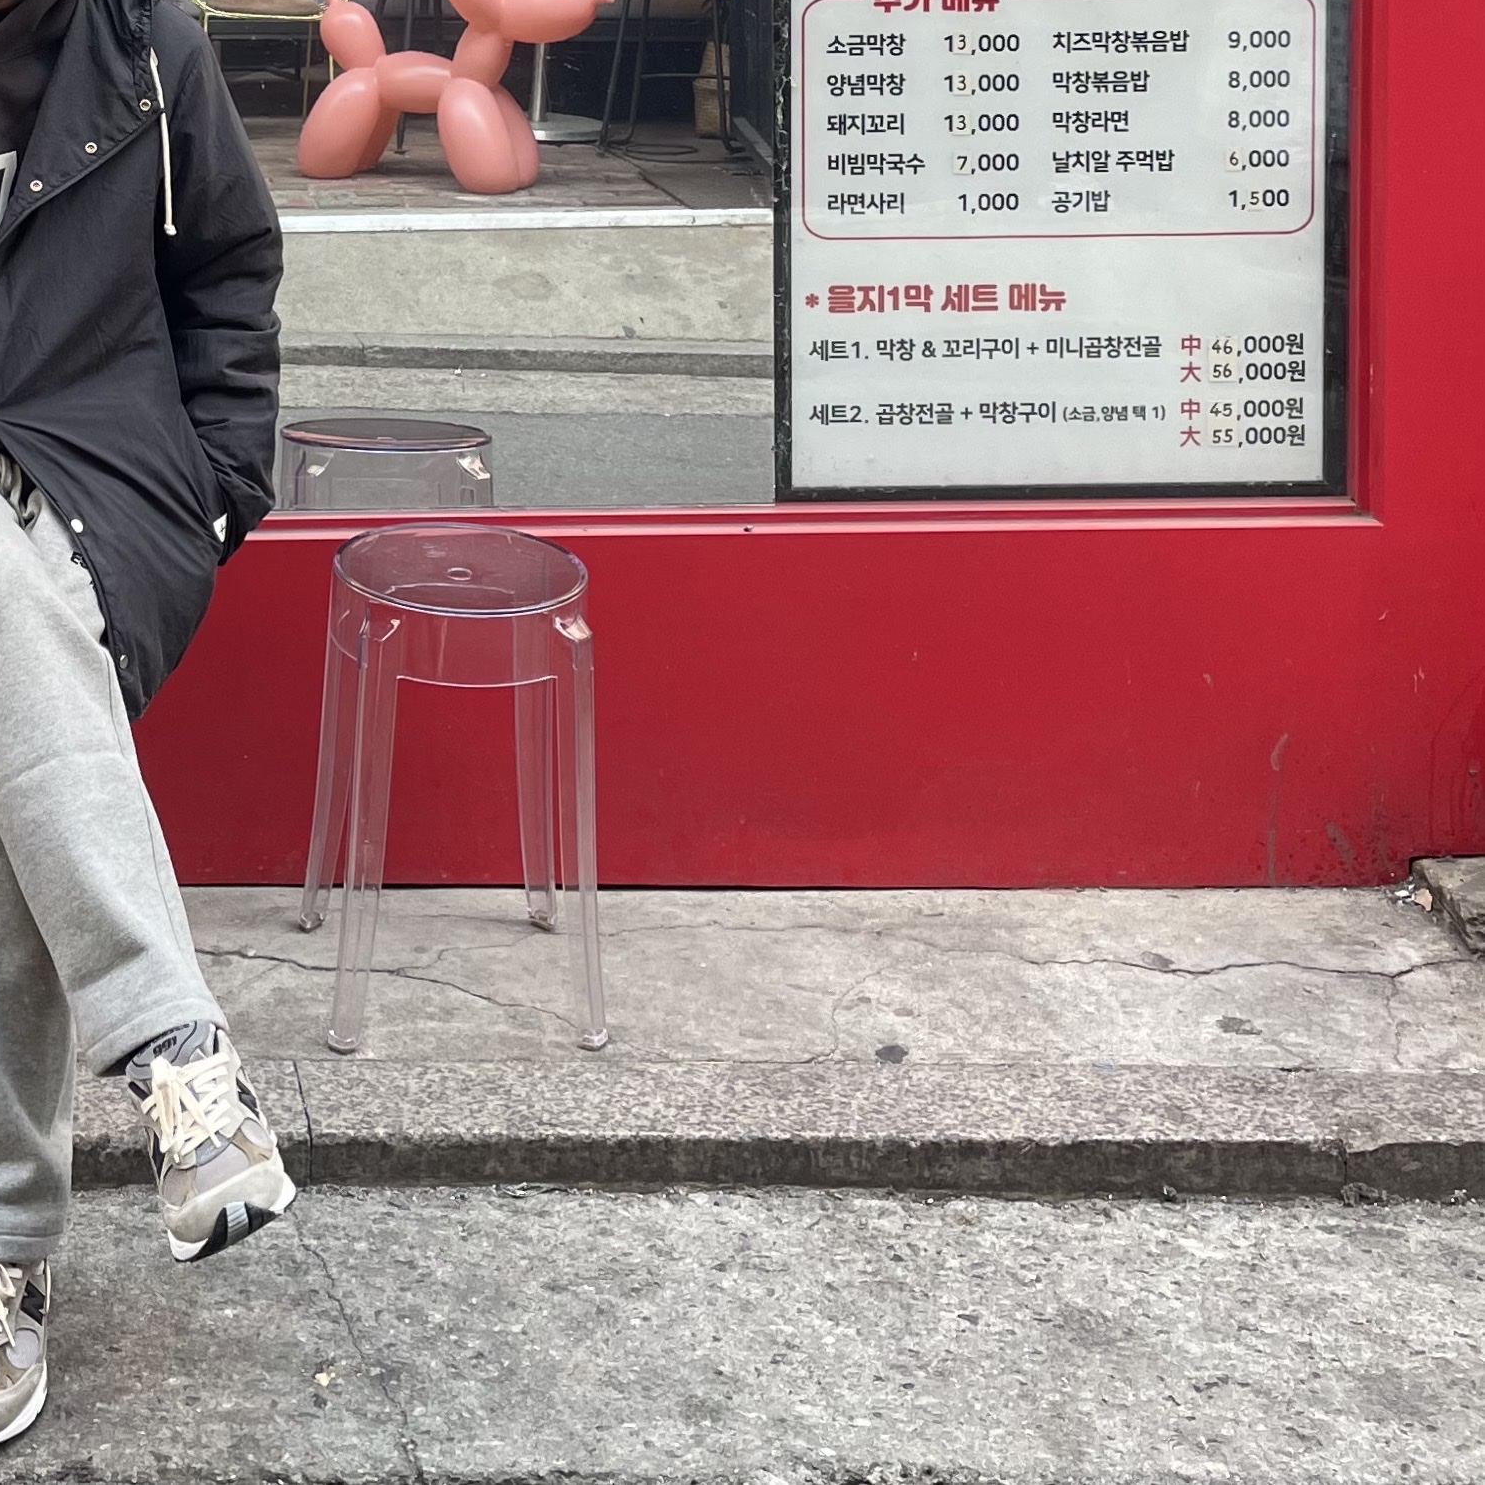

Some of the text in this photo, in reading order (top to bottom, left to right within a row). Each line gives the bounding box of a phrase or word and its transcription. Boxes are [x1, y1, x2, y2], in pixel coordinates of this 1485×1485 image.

[826, 30, 1290, 56] 소금막창 13,000 치즈막창볶음밥 9,000
[826, 70, 1290, 96] 양념막창 13,000 막창볶음밥 8,000
[827, 109, 1290, 135] 돼지꼬리 13,000 막창라면 8,000
[828, 149, 1290, 175] 비빔막국수 7,000 날치알 주먹밥 6,000
[827, 189, 1290, 215] 라면사리 1,000 공기밥 1,500
[828, 284, 1066, 313] 을지1막 세트 메뉴
[810, 334, 1304, 361] 세트1. 막창 & 꼬리구이 + 미니곱창전골 中 46,000원
[1180, 362, 1306, 383] 大 56,000원
[810, 404, 869, 425] 세트2.
[876, 403, 954, 425] 곱창전골
[960, 407, 973, 421] +
[979, 402, 1056, 424] 막창구이
[1132, 405, 1147, 422] 택
[1152, 404, 1166, 422] 1)
[1181, 399, 1201, 419] 中
[1210, 398, 1304, 420] 45,000원
[1180, 425, 1306, 447] 大 55,000원
